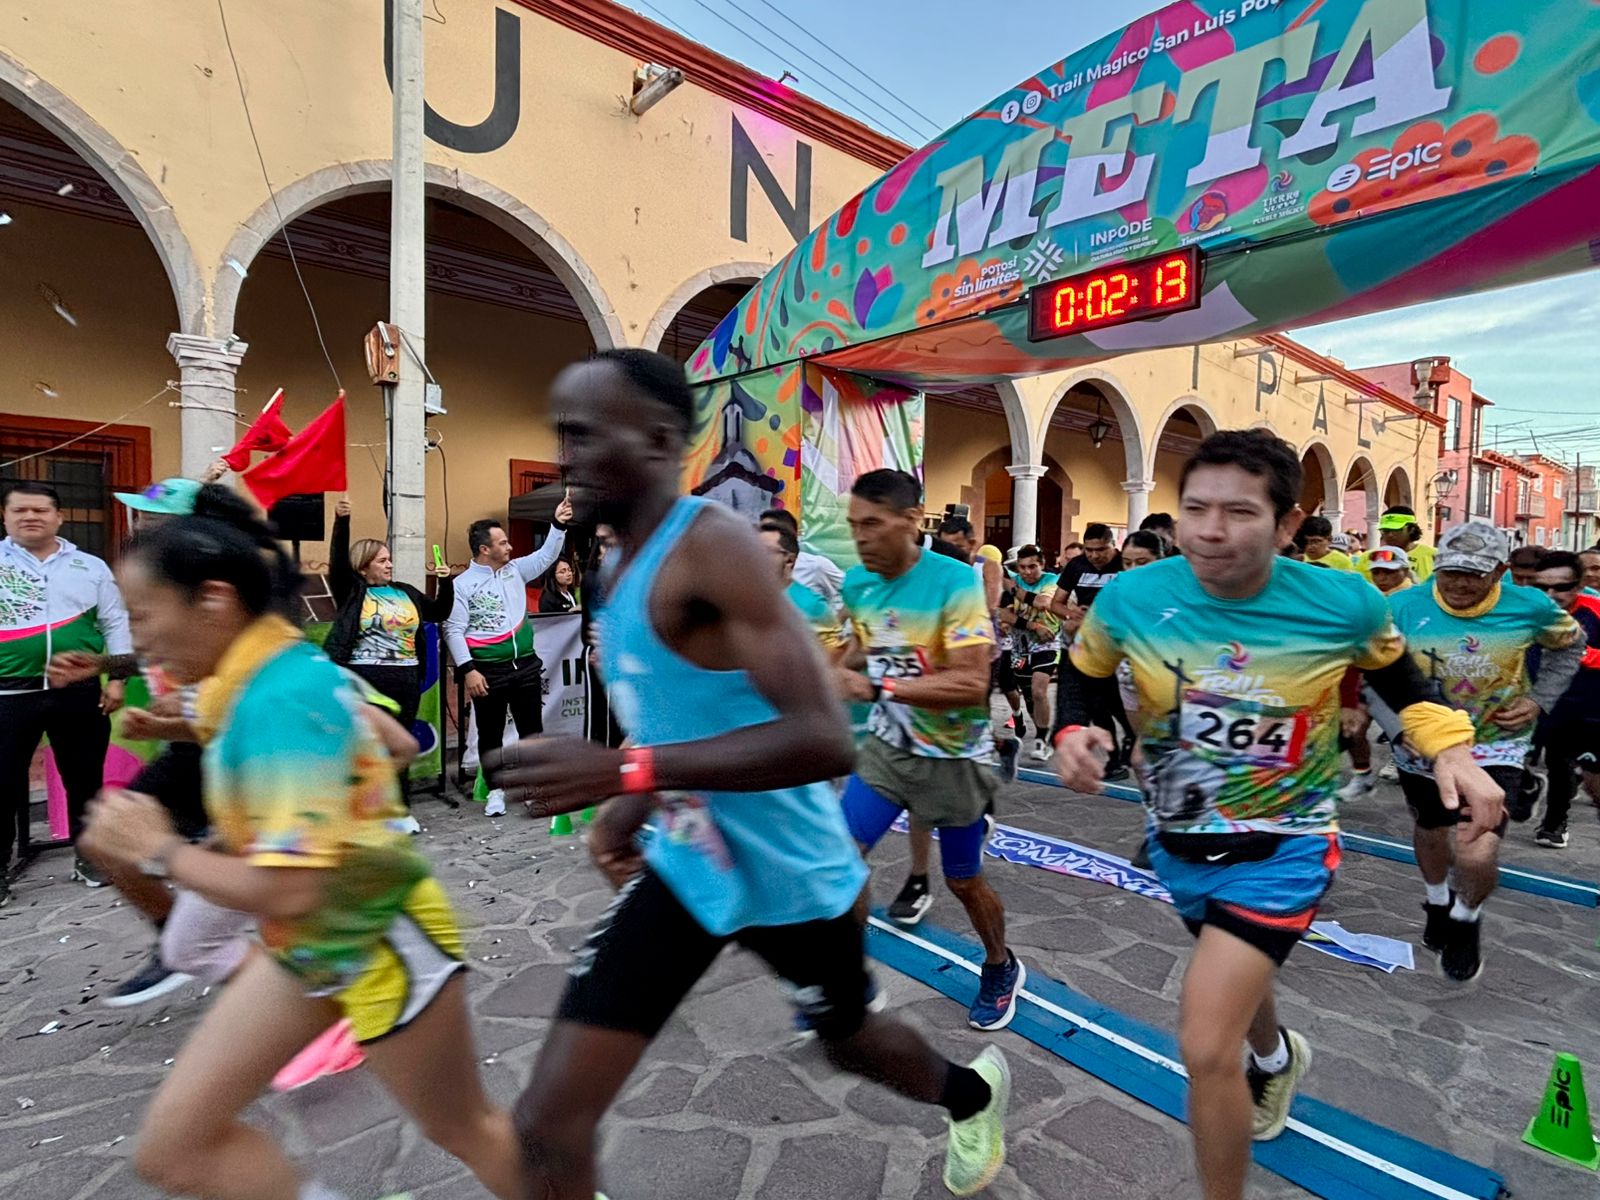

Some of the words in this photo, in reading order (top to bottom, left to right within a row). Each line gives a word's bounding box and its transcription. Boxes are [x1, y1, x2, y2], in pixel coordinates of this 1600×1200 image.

[1048, 72, 1083, 100] Trail
[1086, 47, 1149, 83] Magico
[1153, 29, 1190, 53] San
[1194, 8, 1237, 38] Luis
[921, 0, 1453, 269] META
[1090, 217, 1153, 248] INPODE
[954, 281, 974, 297] sin
[561, 696, 585, 708] INST
[561, 707, 584, 718] CUL
[1195, 711, 1287, 753] 264
